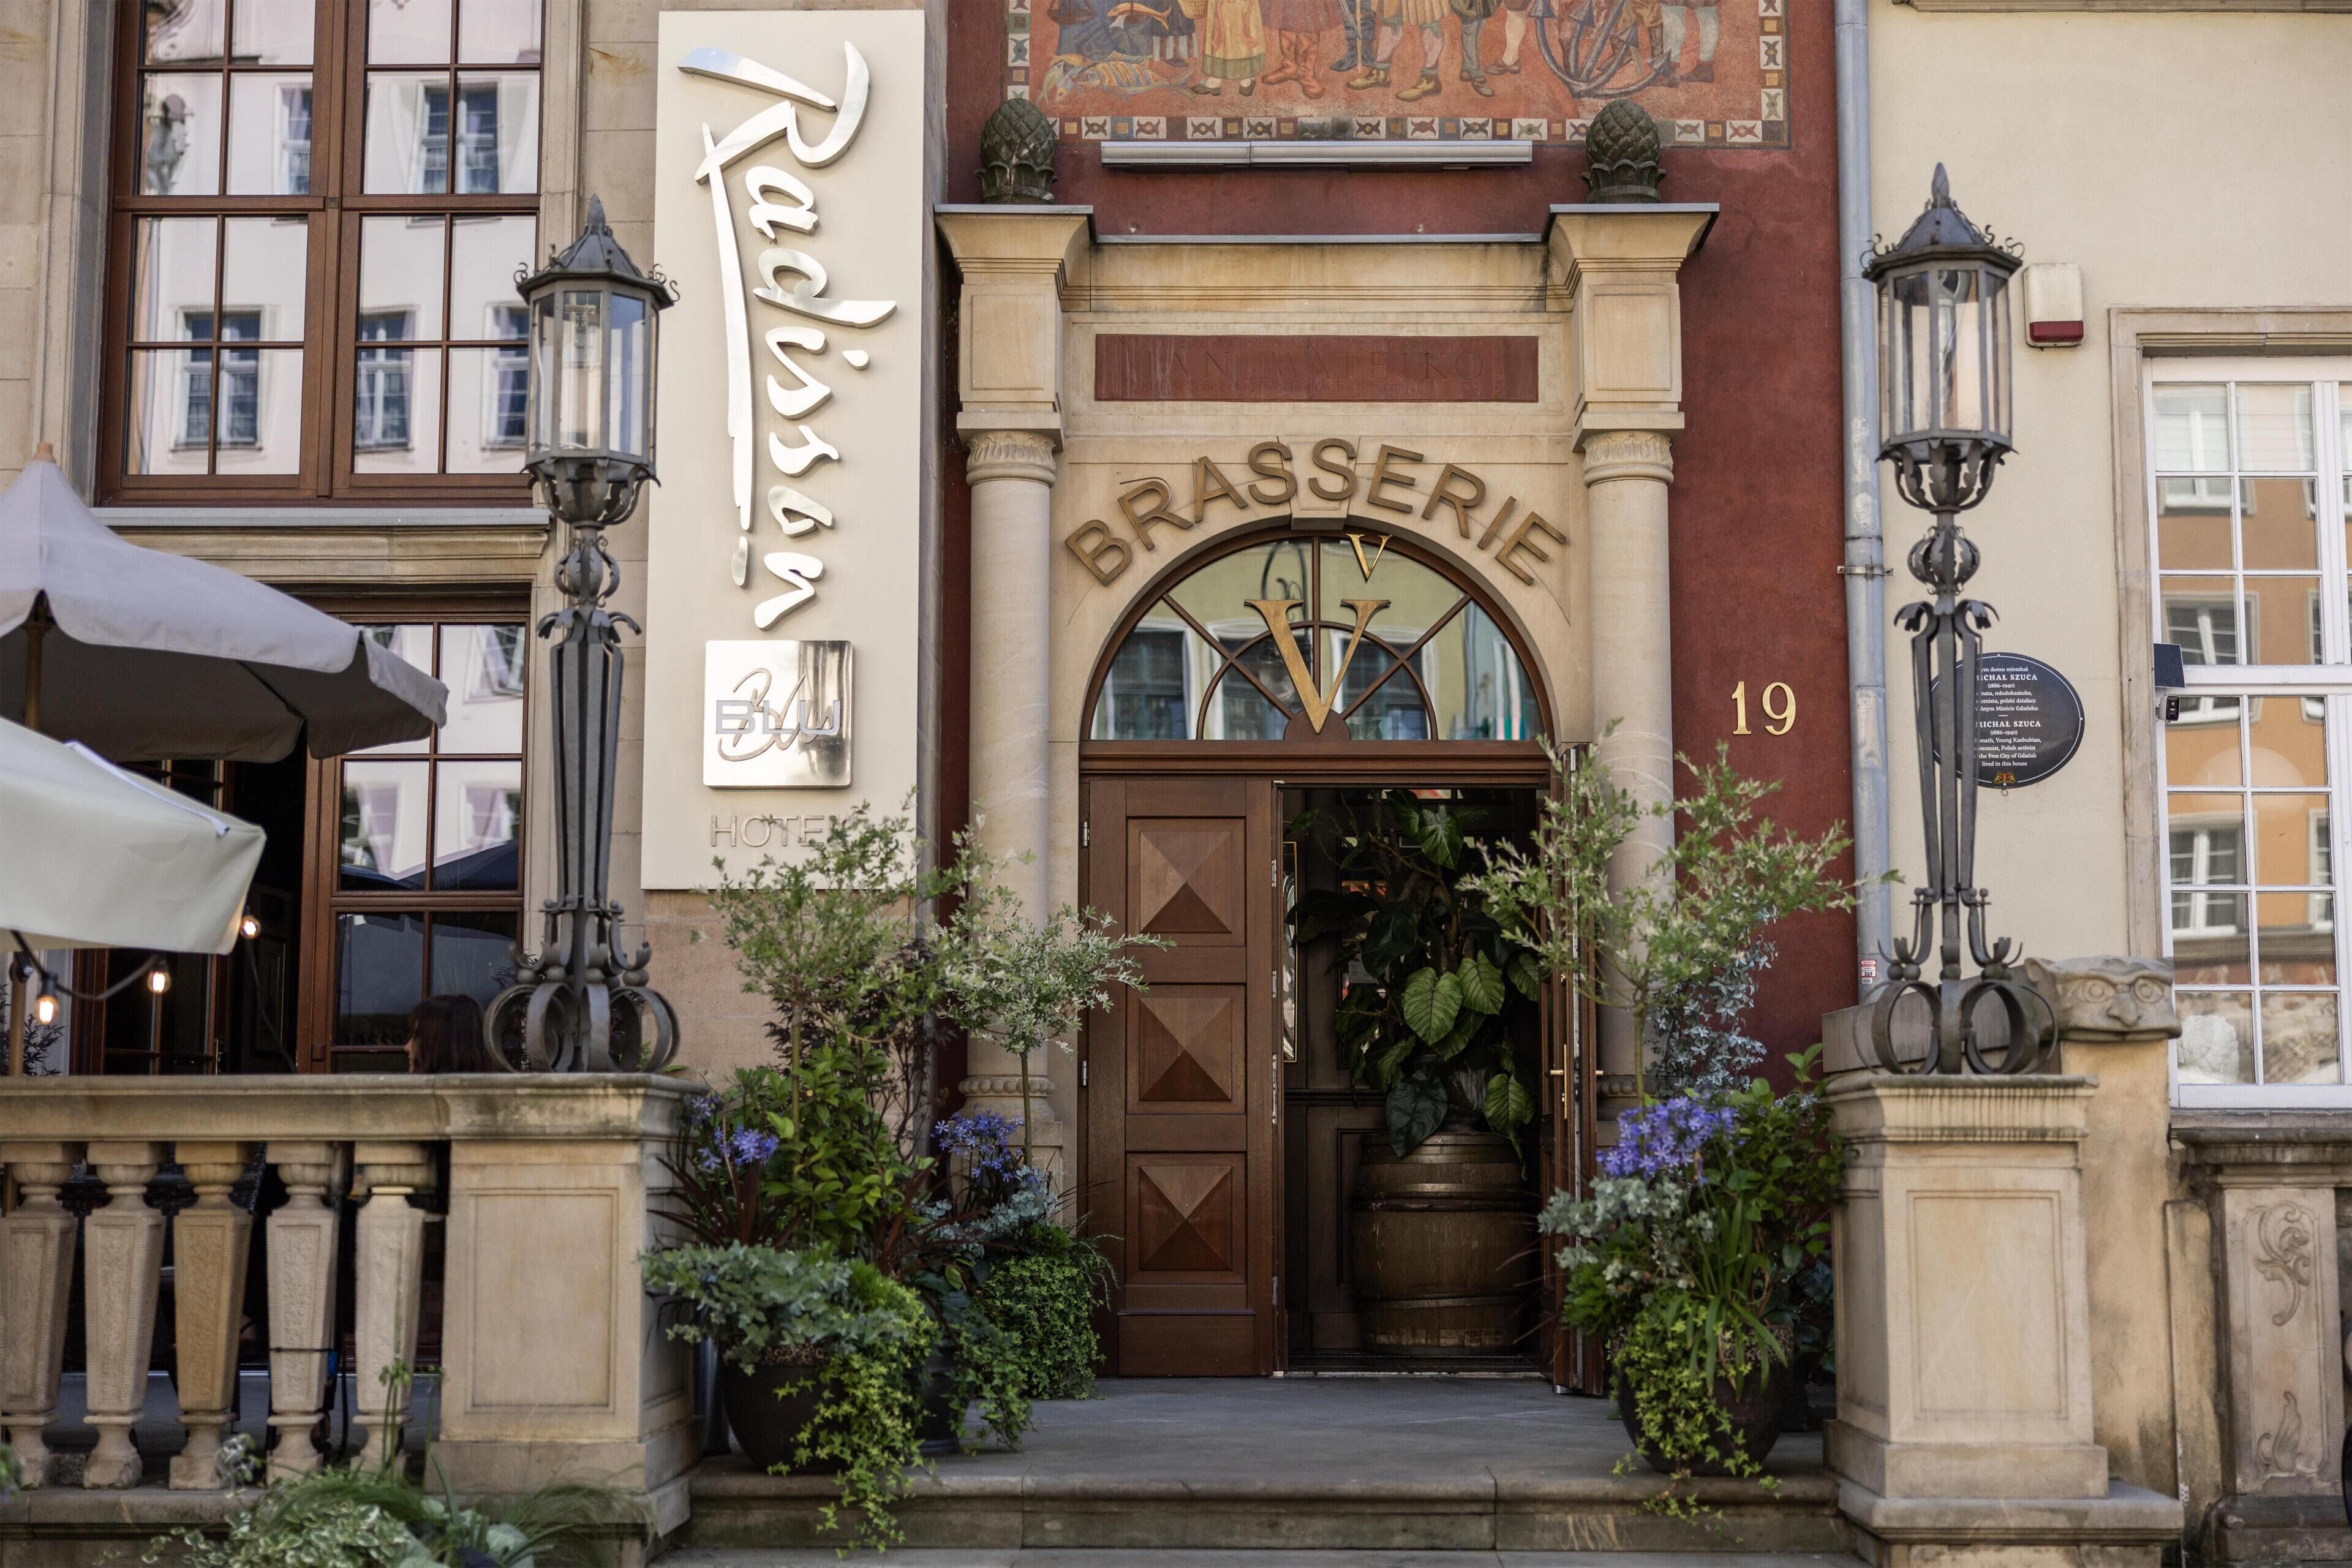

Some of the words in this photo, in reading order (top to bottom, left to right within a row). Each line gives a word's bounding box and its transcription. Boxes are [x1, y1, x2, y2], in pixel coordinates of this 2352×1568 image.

[677, 41, 898, 630] Radisson
[1144, 351, 1229, 381] JAN
[1262, 351, 1483, 382] MATEJKO
[1065, 438, 1568, 586] BRASSERIE
[715, 699, 840, 734] BLU
[1732, 681, 1796, 736] 19
[711, 815, 827, 847] HOTE
